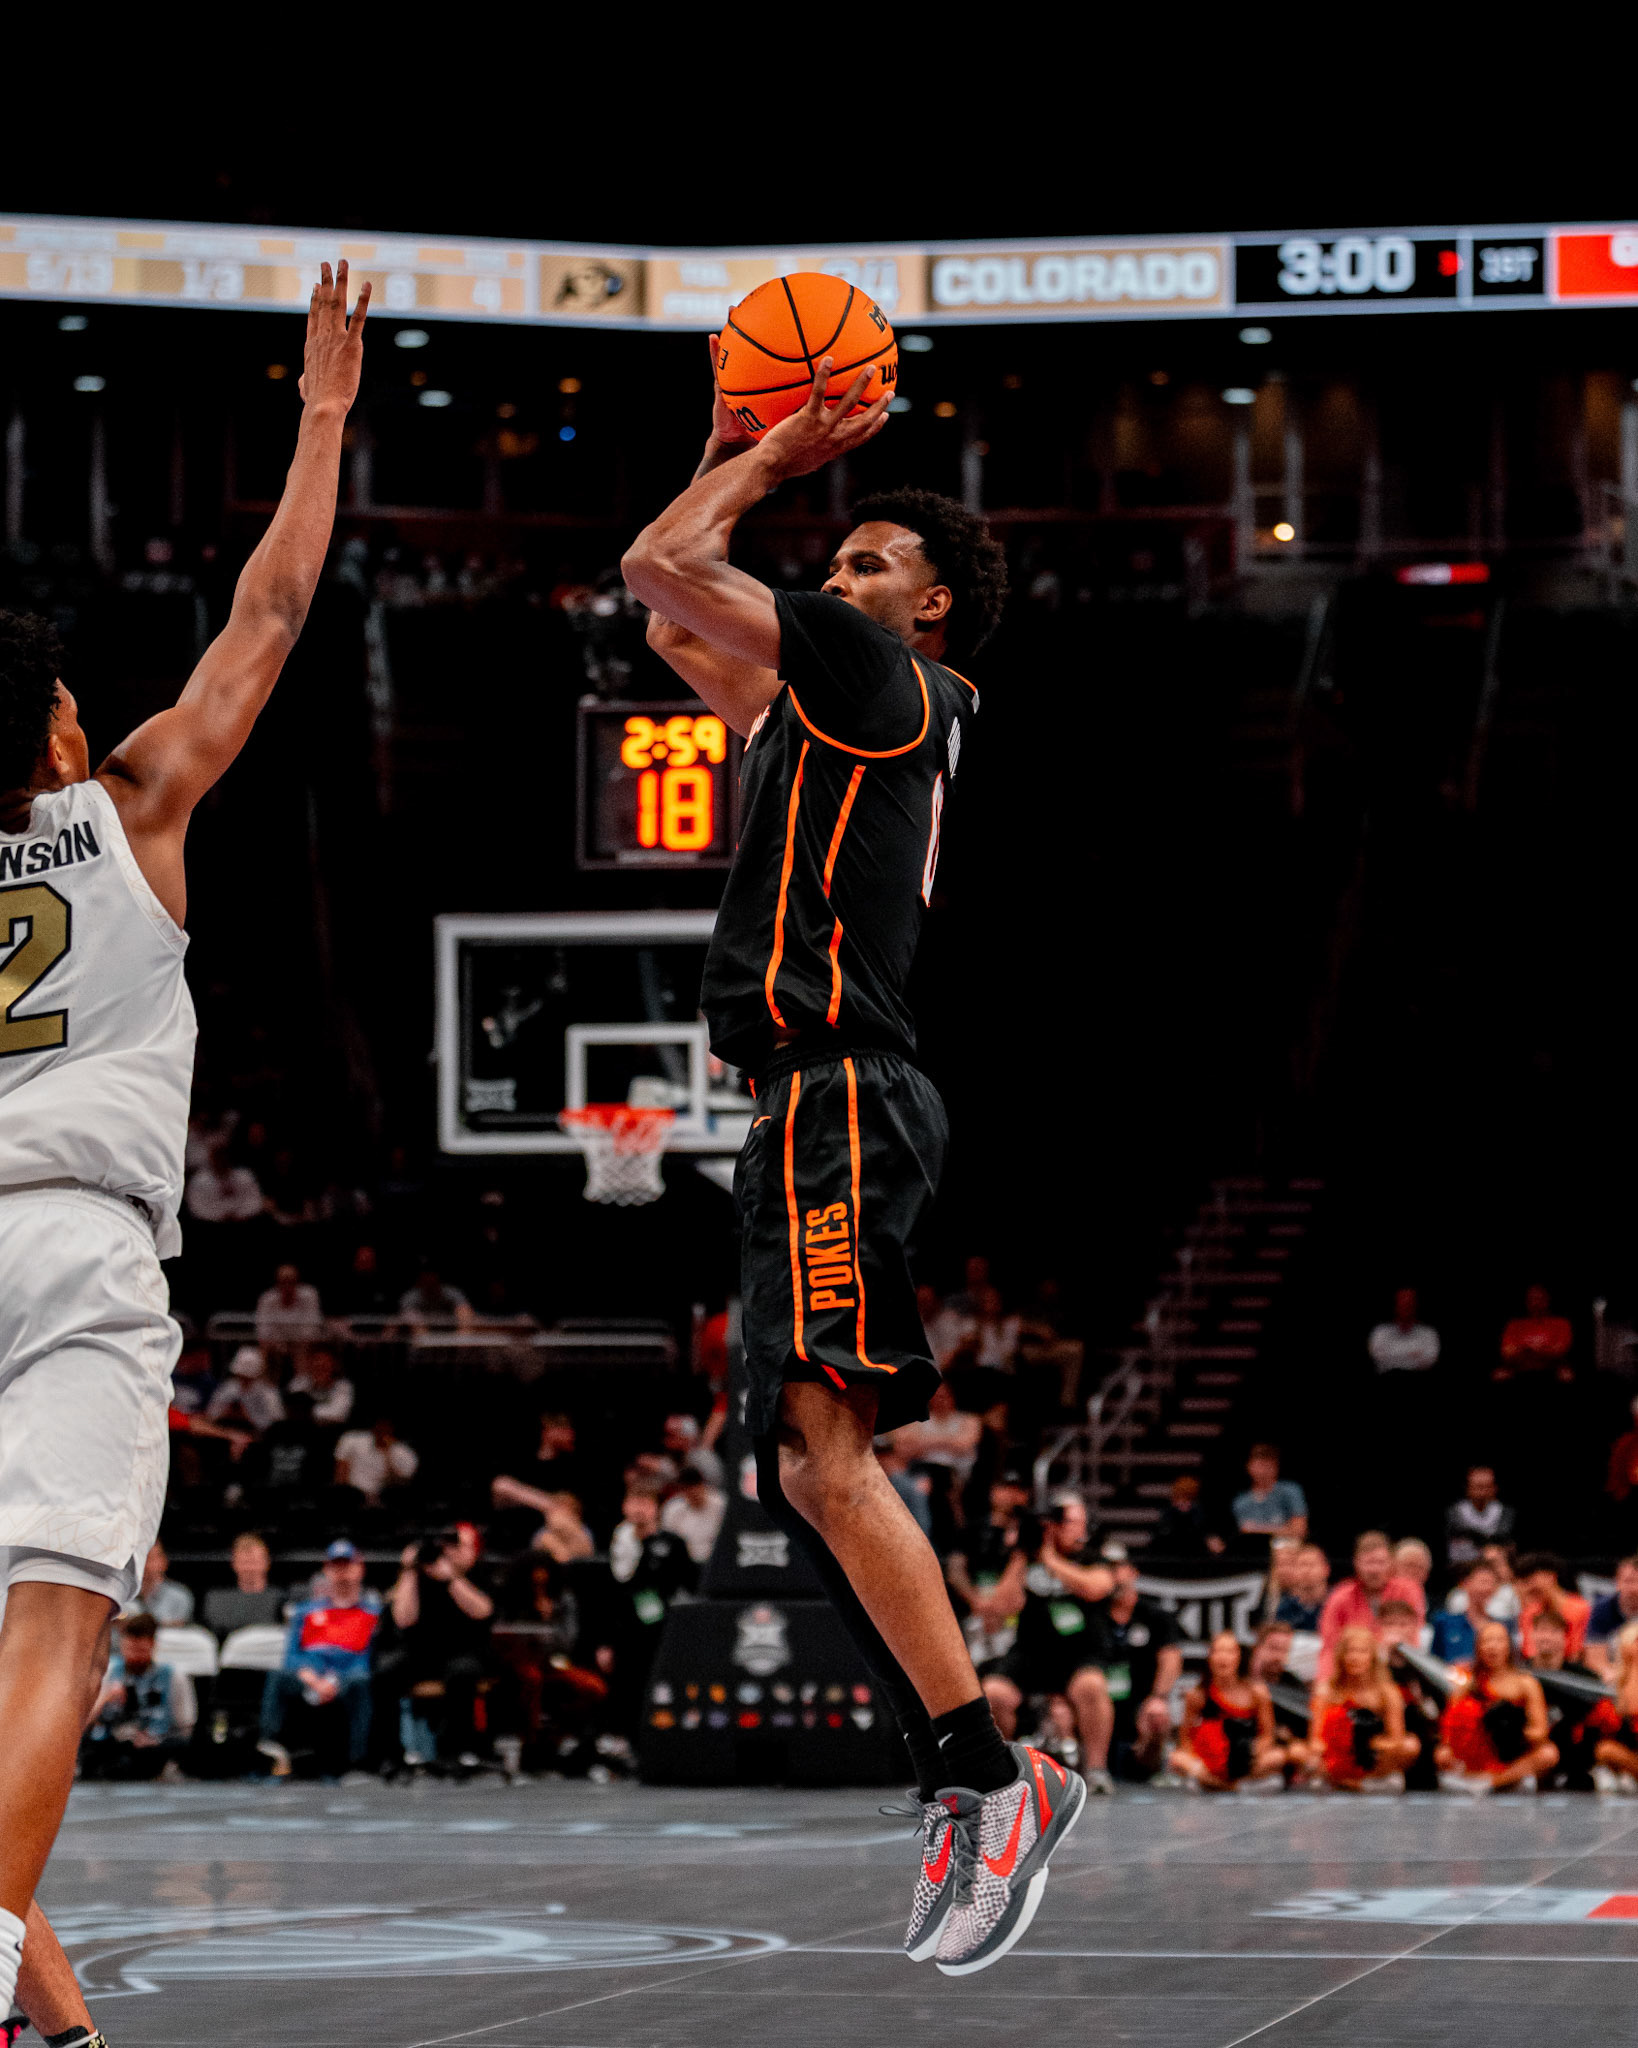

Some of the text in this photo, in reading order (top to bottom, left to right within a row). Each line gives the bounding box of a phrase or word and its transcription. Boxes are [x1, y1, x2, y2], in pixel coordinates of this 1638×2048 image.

[932, 252, 1219, 306] COLORADO
[1278, 237, 1415, 294] 3:00
[621, 715, 728, 770] 2:59
[637, 765, 714, 852] 18
[804, 1200, 856, 1312] POKES
